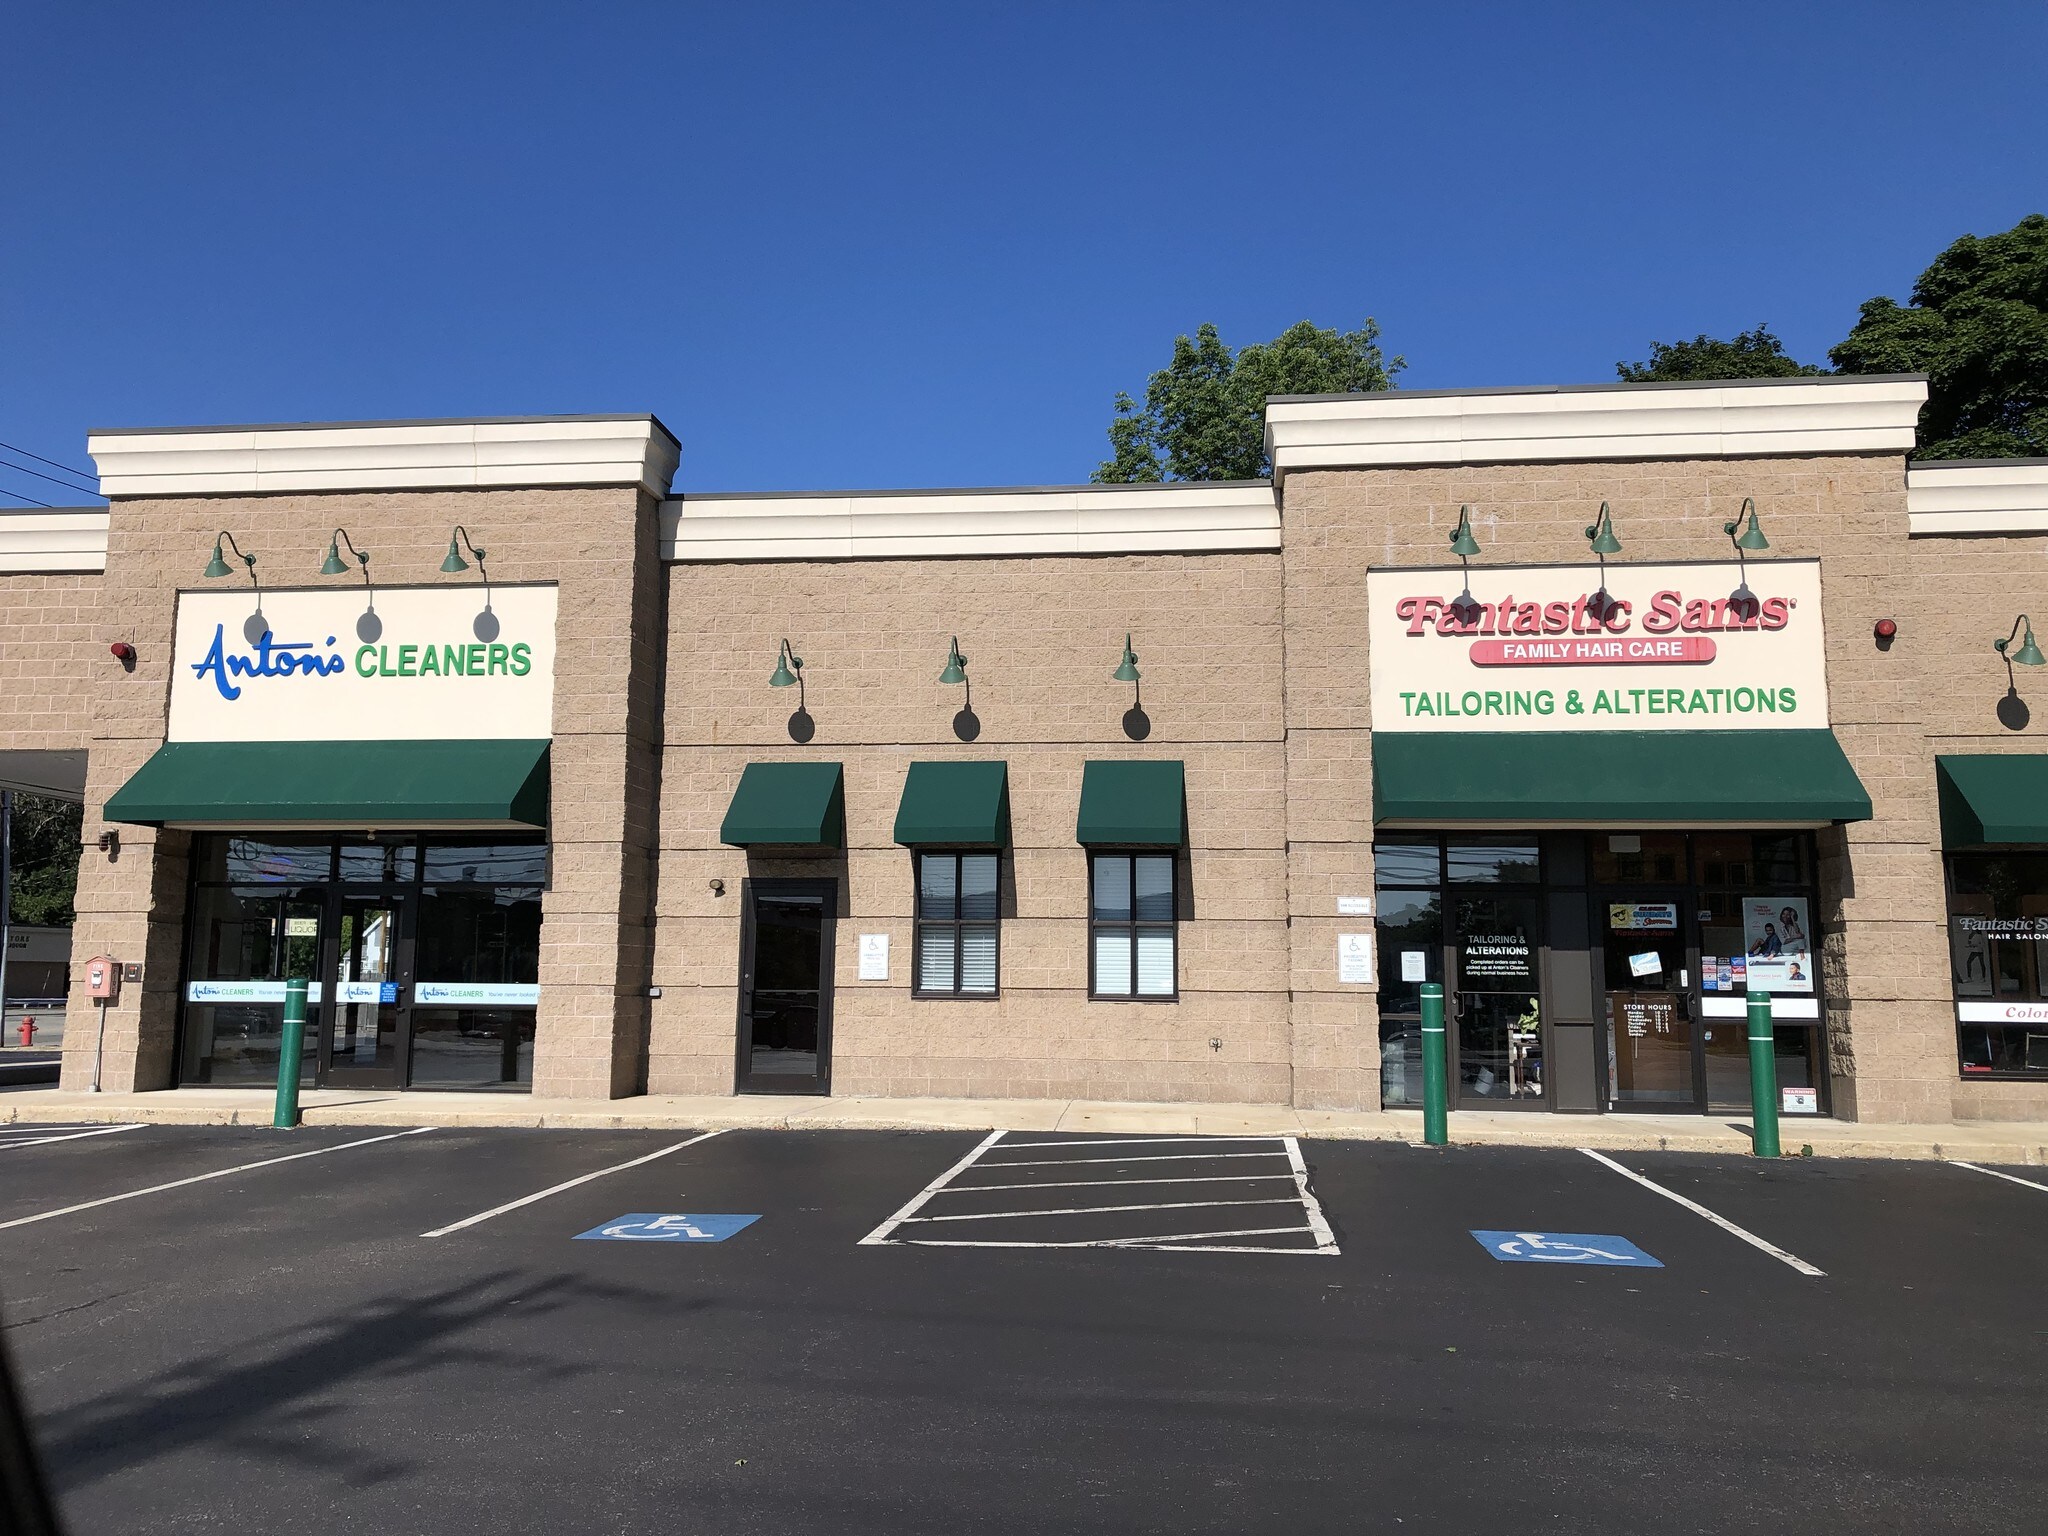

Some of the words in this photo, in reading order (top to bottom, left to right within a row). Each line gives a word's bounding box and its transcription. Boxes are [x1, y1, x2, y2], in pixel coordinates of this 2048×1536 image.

[1396, 592, 1632, 637] Fantastic
[1503, 643, 1571, 659] FAMILY
[1576, 642, 1622, 658] HAIR
[1628, 641, 1683, 657] CARE
[191, 623, 345, 700] Anton's
[355, 642, 531, 678] CLEANERS
[1400, 690, 1554, 717] TAILORING
[1565, 690, 1584, 714] &
[1593, 687, 1797, 715] ALTERATIONS
[1960, 916, 2033, 930] Fantastic
[1468, 935, 1516, 943] TAILORING
[1466, 947, 1529, 955] ALTERATIONS
[192, 984, 220, 998] Anton's
[344, 985, 373, 999] Anton's
[420, 985, 449, 1000] Anton's
